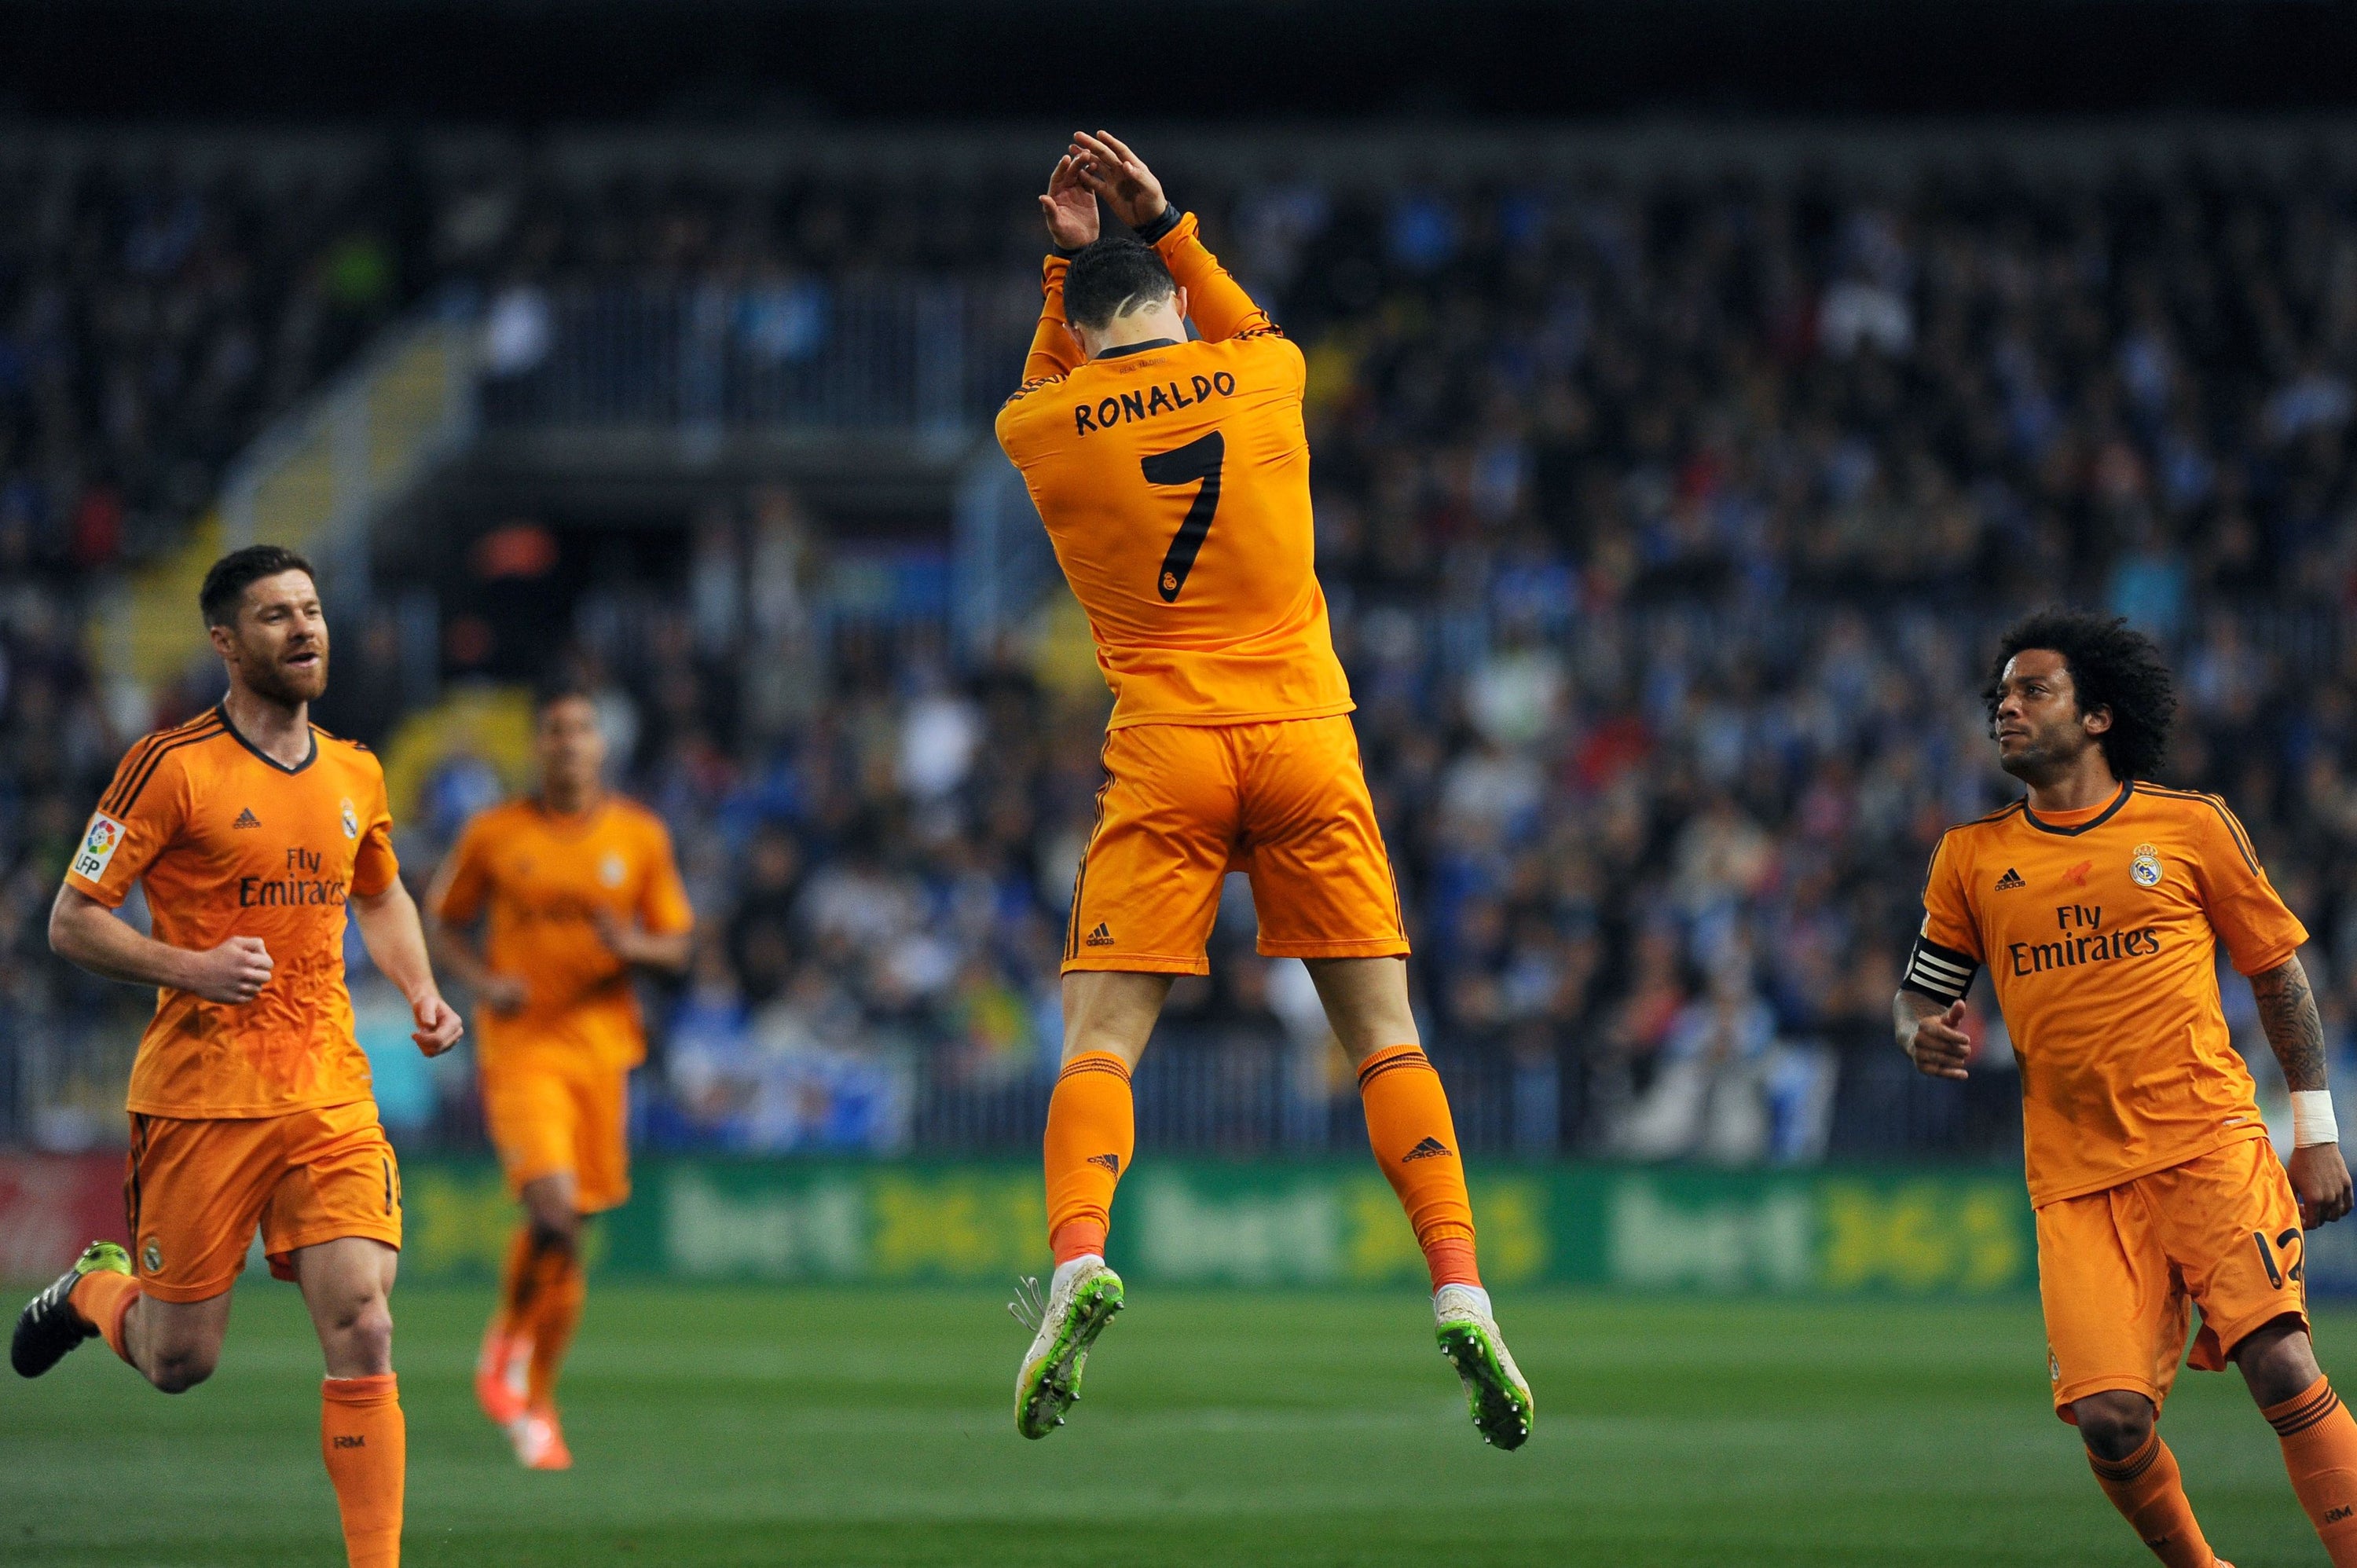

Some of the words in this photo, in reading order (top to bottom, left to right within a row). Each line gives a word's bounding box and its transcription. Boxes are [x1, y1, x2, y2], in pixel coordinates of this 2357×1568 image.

[1075, 371, 1236, 437] RONALDO
[1140, 429, 1226, 603] 7
[75, 853, 101, 875] LFP
[287, 847, 321, 874] Fly
[1994, 879, 2026, 892] adidas
[2056, 904, 2102, 930] Fly
[1086, 937, 1115, 947] adidas
[2008, 928, 2161, 977] Emirates
[1402, 1149, 1453, 1163] adidas
[2253, 1227, 2303, 1290] 12
[2324, 1504, 2353, 1524] RM
